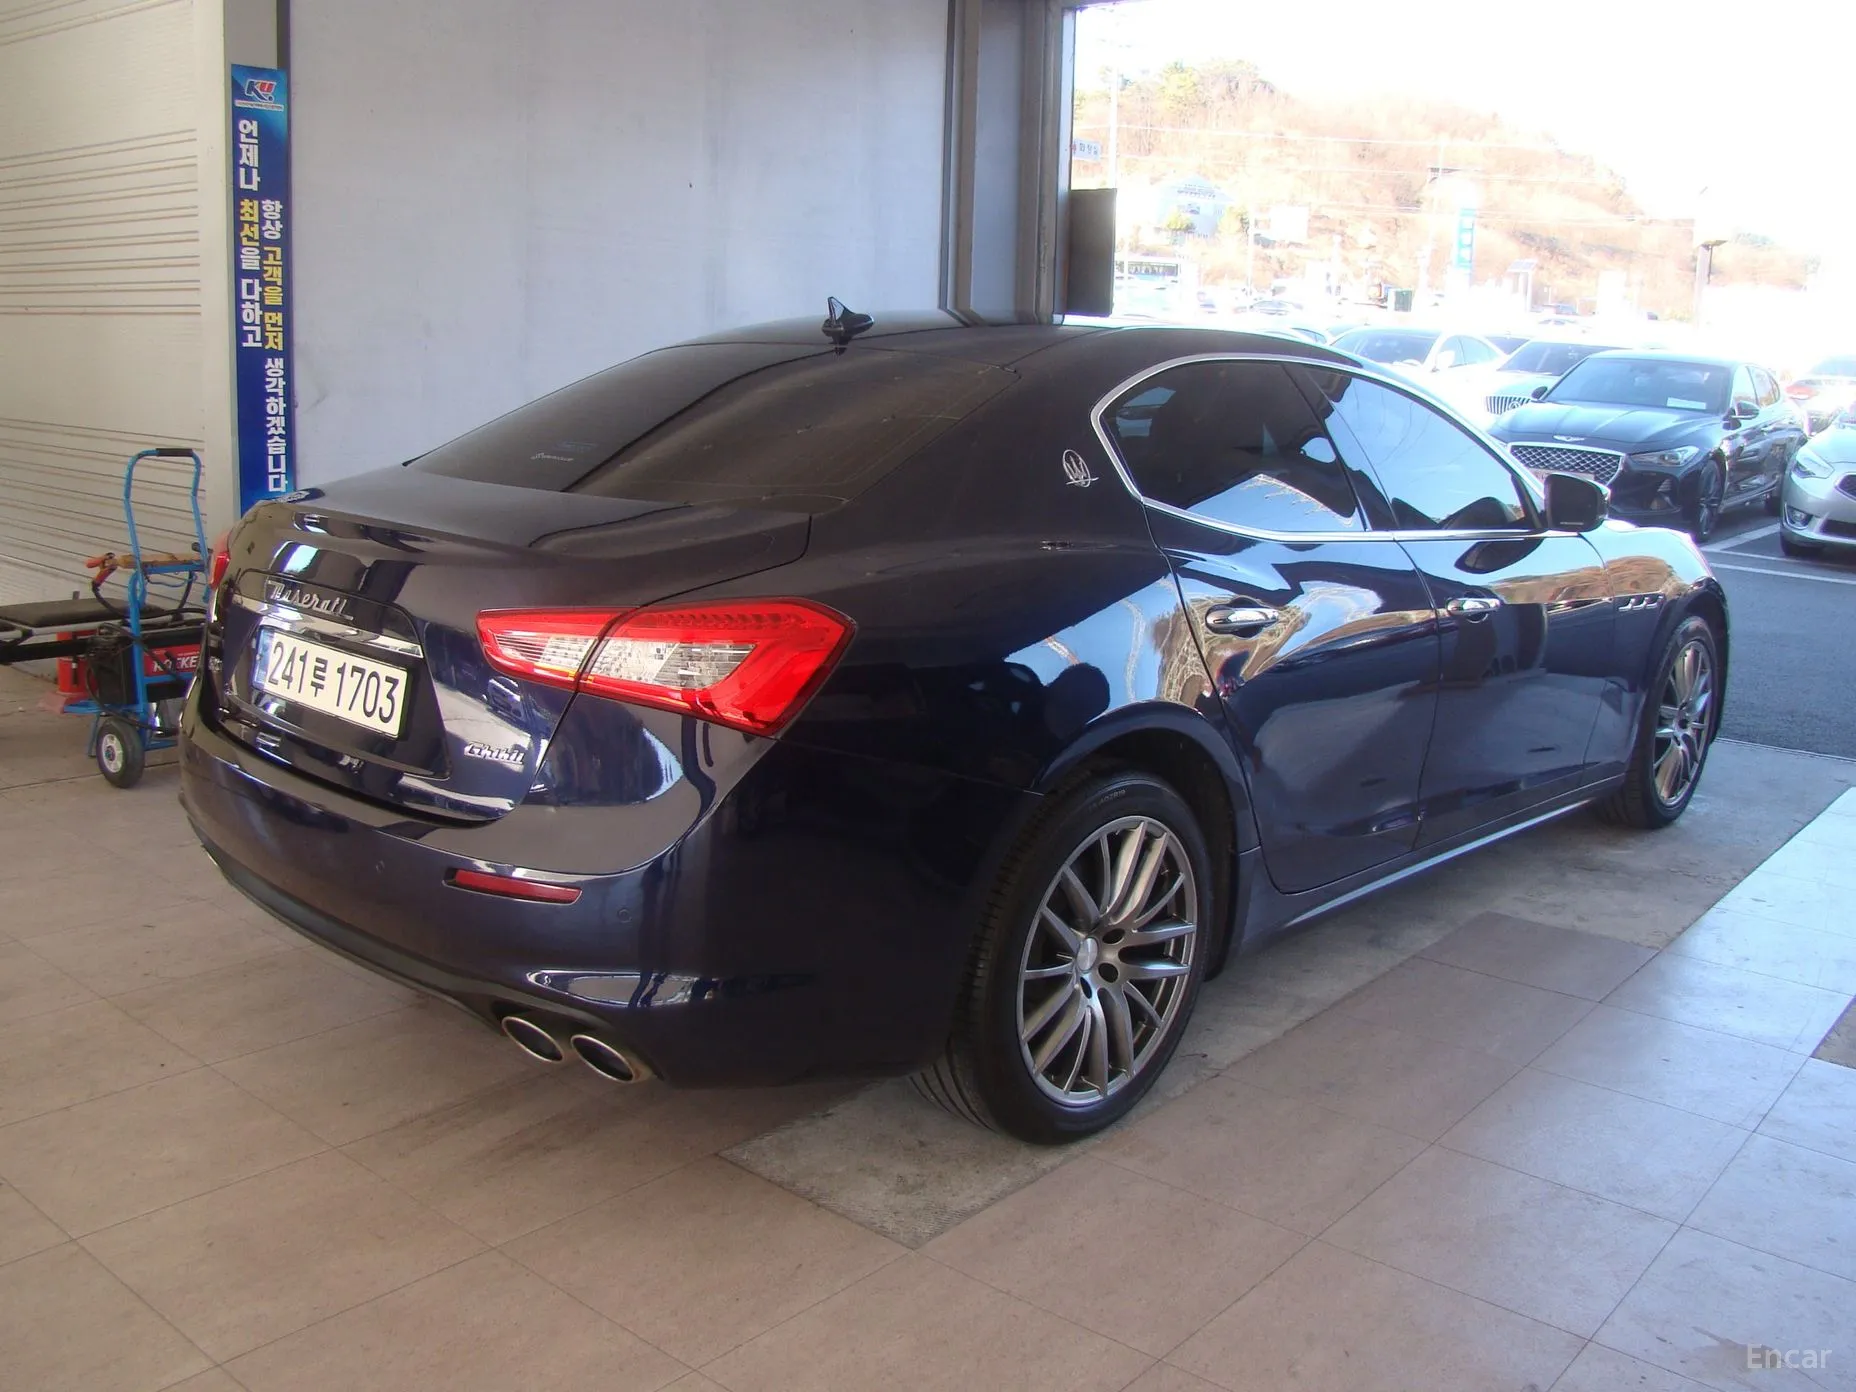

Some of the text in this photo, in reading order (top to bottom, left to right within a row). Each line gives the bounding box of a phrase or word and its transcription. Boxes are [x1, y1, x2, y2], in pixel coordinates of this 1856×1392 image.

[239, 119, 261, 192] 언제나
[240, 199, 262, 270] 최선을
[241, 278, 263, 348] 다하고
[262, 199, 288, 493] 항상 고객을 먼저 생각하겠습니다
[267, 580, 354, 621] Maserati
